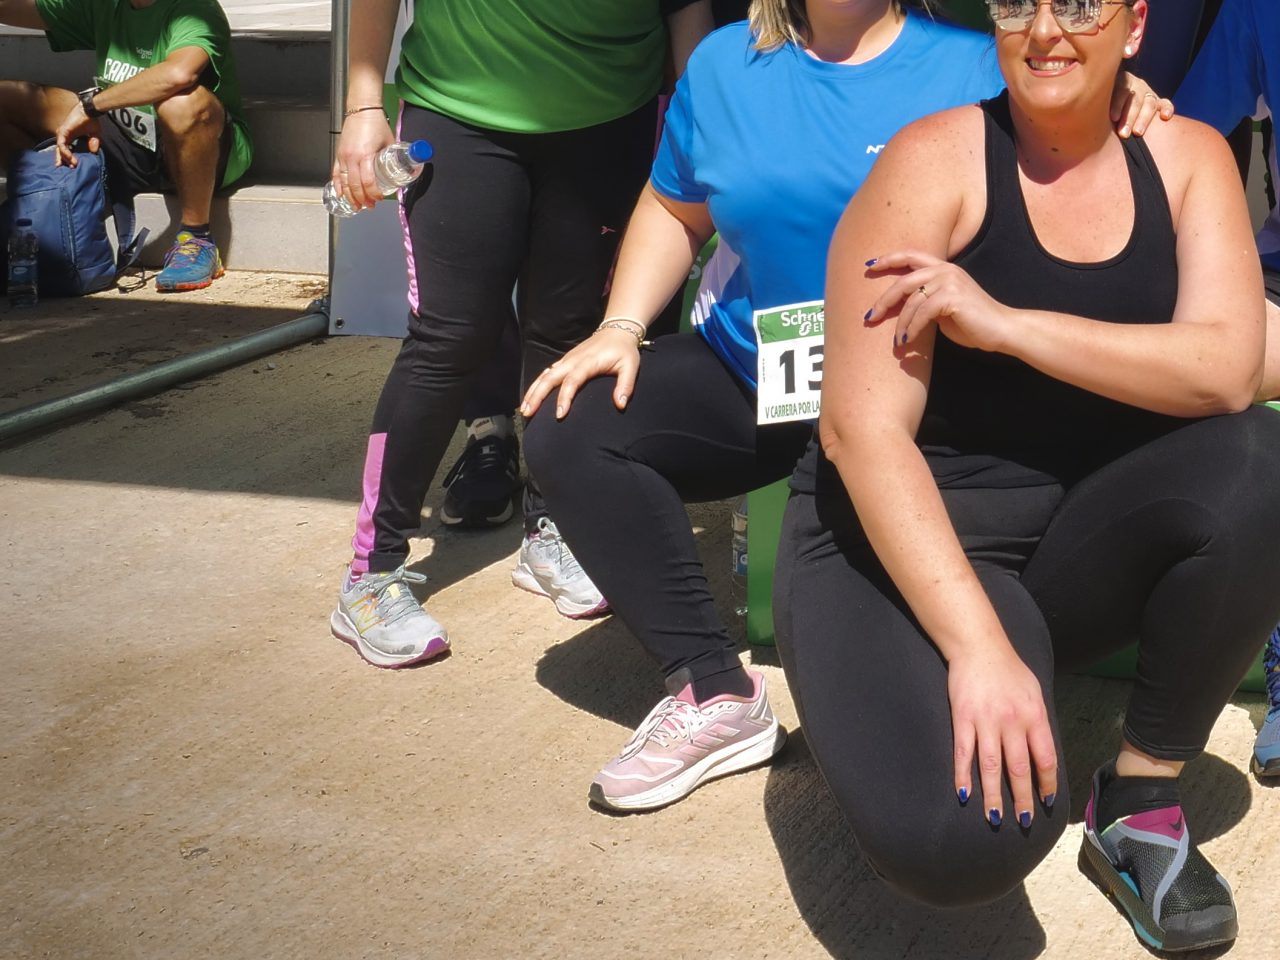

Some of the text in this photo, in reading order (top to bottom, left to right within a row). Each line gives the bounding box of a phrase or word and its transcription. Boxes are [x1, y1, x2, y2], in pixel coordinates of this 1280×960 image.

[780, 309, 825, 327] Schne
[779, 344, 825, 394] 13
[765, 400, 820, 419] V CARRERA POR LA
